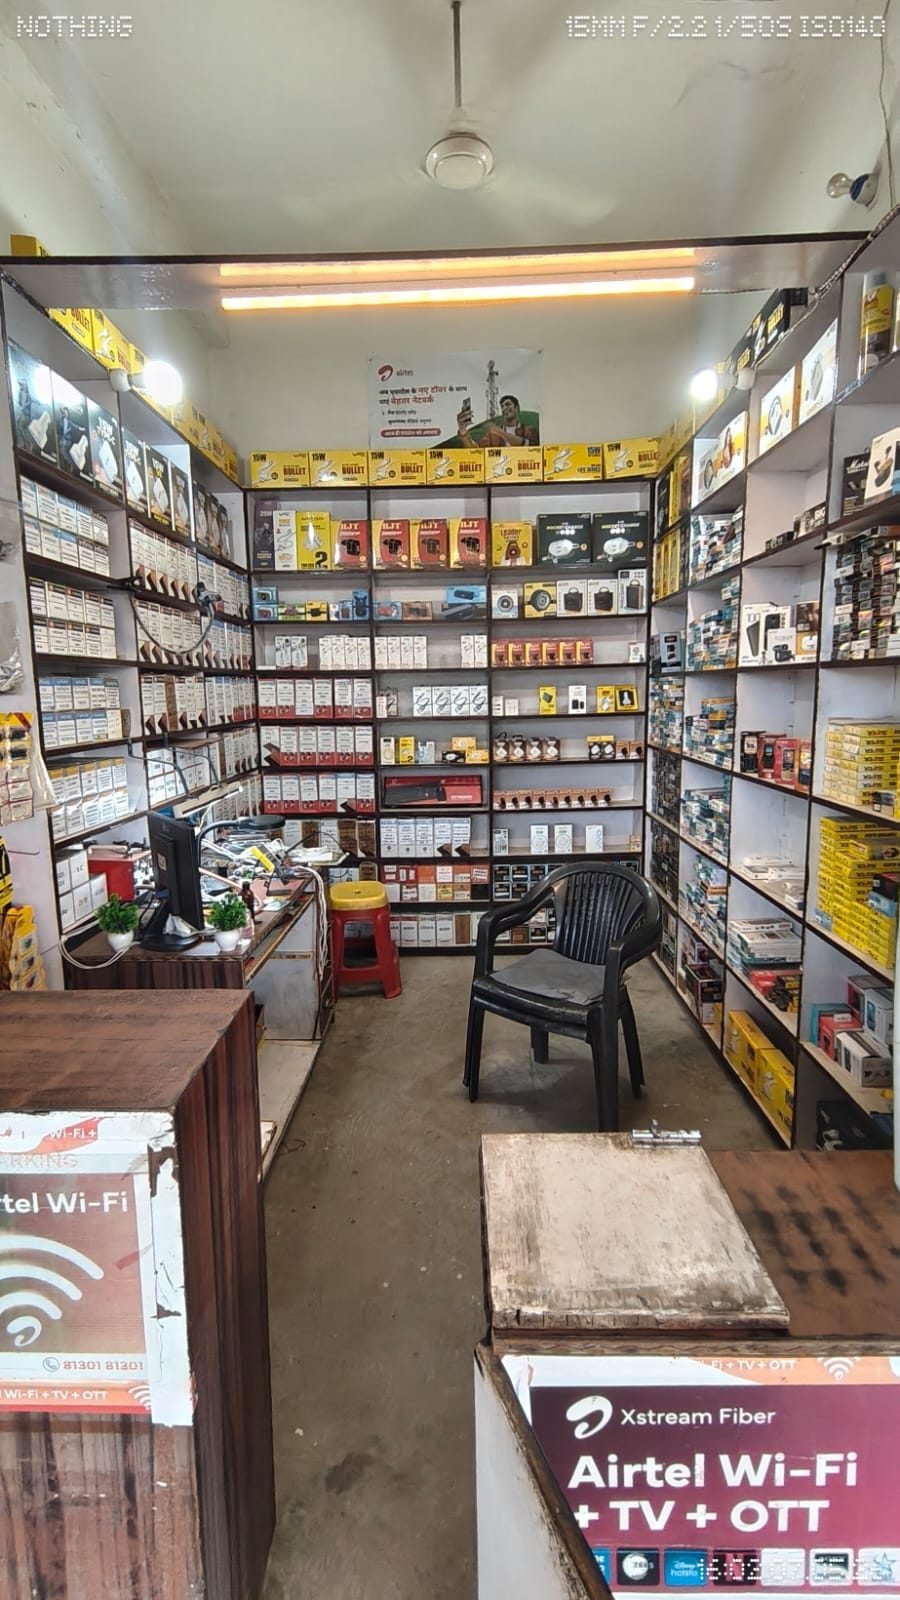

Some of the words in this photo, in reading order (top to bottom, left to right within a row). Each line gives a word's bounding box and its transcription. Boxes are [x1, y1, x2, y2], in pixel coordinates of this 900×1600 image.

[315, 551, 328, 569] 2
[49, 1128, 85, 1139] Wi-Fi
[0, 1192, 39, 1214] tel
[46, 1192, 128, 1214] Wi-Fi
[63, 1360, 102, 1371] 81301
[105, 1360, 144, 1371] 81301
[726, 1360, 735, 1368] +
[737, 1359, 754, 1370] TV
[757, 1360, 766, 1368] +
[769, 1359, 797, 1371] OTT
[4, 1389, 39, 1400] Wi-Fi
[42, 1391, 49, 1399] +
[51, 1390, 69, 1400] TV
[71, 1391, 79, 1399] +
[82, 1390, 109, 1401] OTT
[620, 1408, 712, 1425] Xstream
[719, 1407, 776, 1424] Fiber
[567, 1453, 705, 1488] Airtel
[719, 1452, 857, 1488] Wi-Fi
[574, 1504, 599, 1528] +
[609, 1500, 675, 1531] TV
[686, 1504, 717, 1528] +
[730, 1500, 830, 1532] OTT
